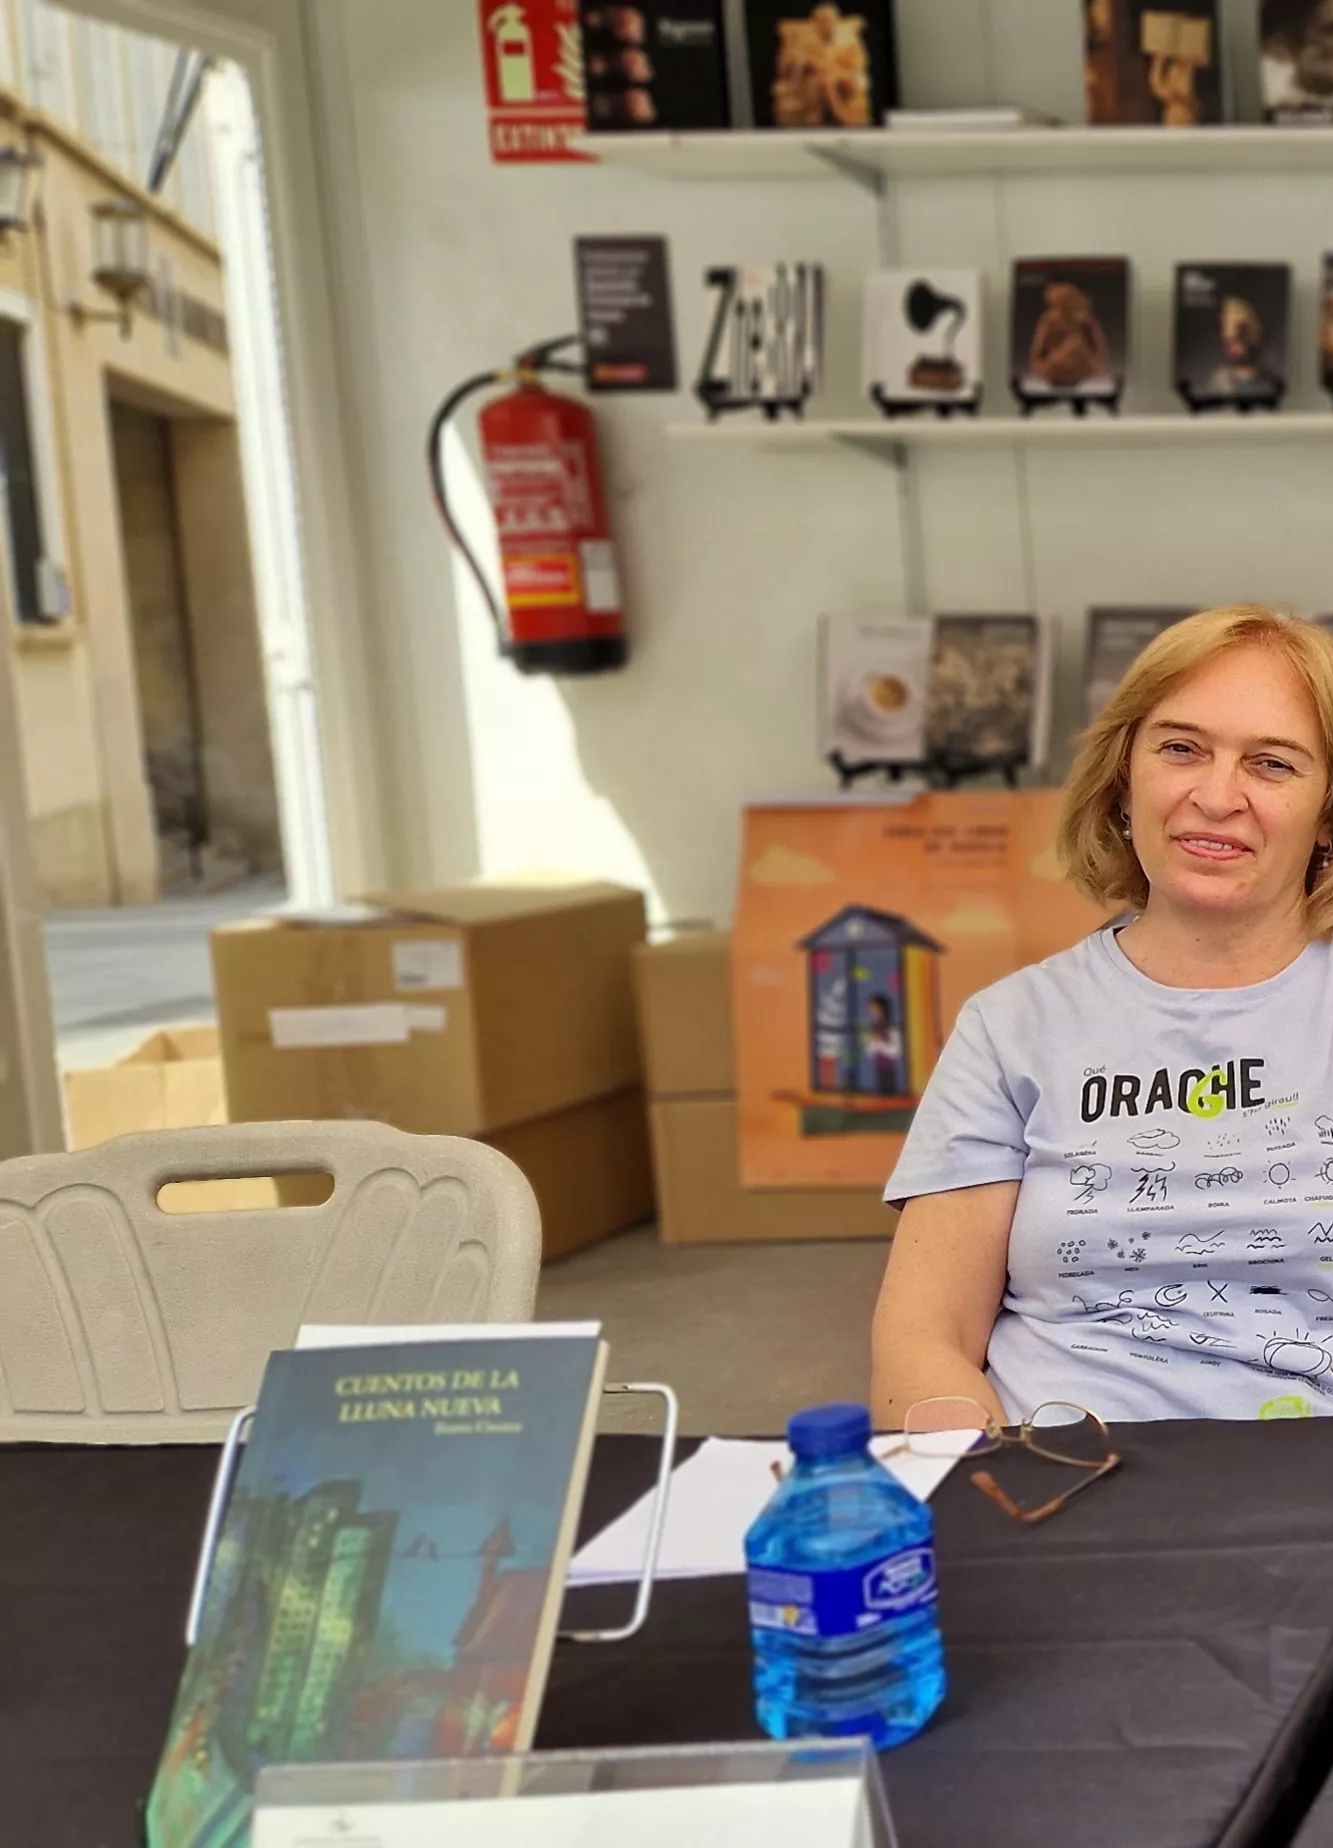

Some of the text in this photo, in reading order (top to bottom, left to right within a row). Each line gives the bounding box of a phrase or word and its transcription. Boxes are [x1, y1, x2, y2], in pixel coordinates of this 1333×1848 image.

[1083, 1064, 1107, 1077] Qué
[335, 1368, 520, 1397] CUENTOS DE LA
[338, 1396, 502, 1424] LLUNA NUEVA
